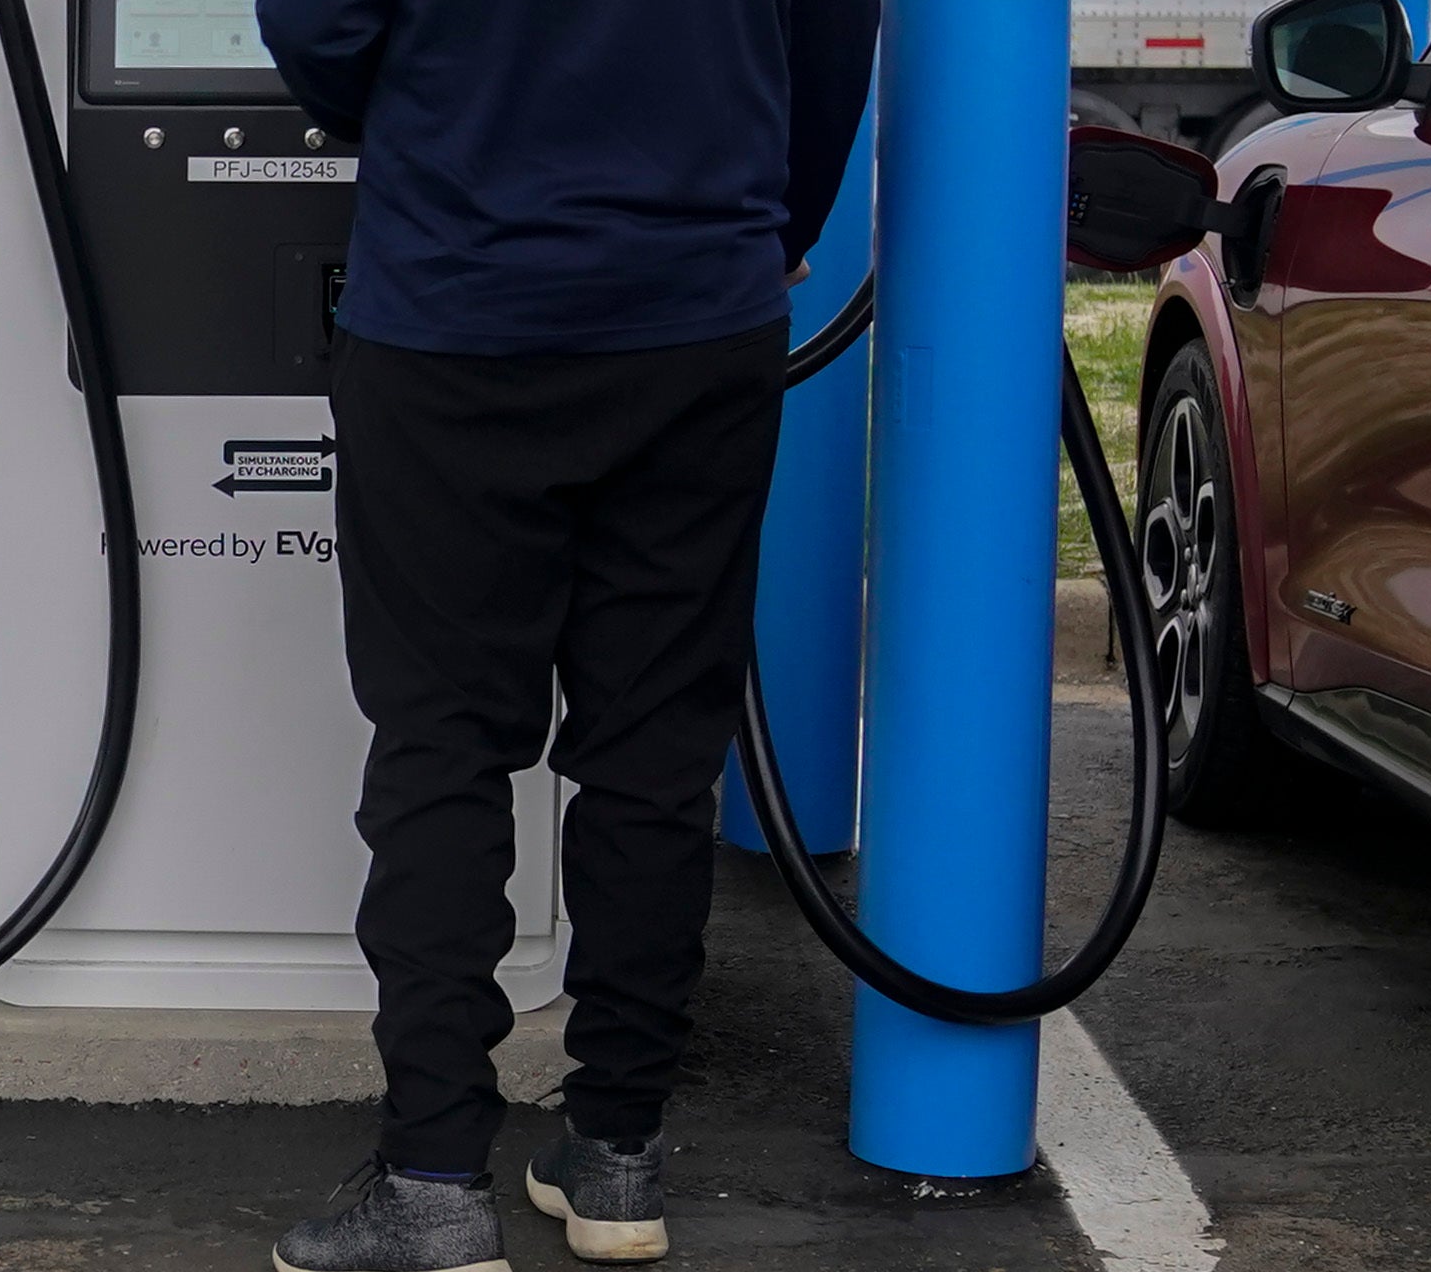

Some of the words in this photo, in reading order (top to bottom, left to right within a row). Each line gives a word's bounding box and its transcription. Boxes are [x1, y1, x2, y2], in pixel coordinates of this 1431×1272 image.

[214, 161, 338, 178] PFJ-C12545
[238, 456, 319, 465] SIMULTANEOUS
[238, 467, 254, 476] EV
[256, 467, 319, 477] CHARGING
[101, 532, 225, 556] wered
[232, 532, 266, 563] by
